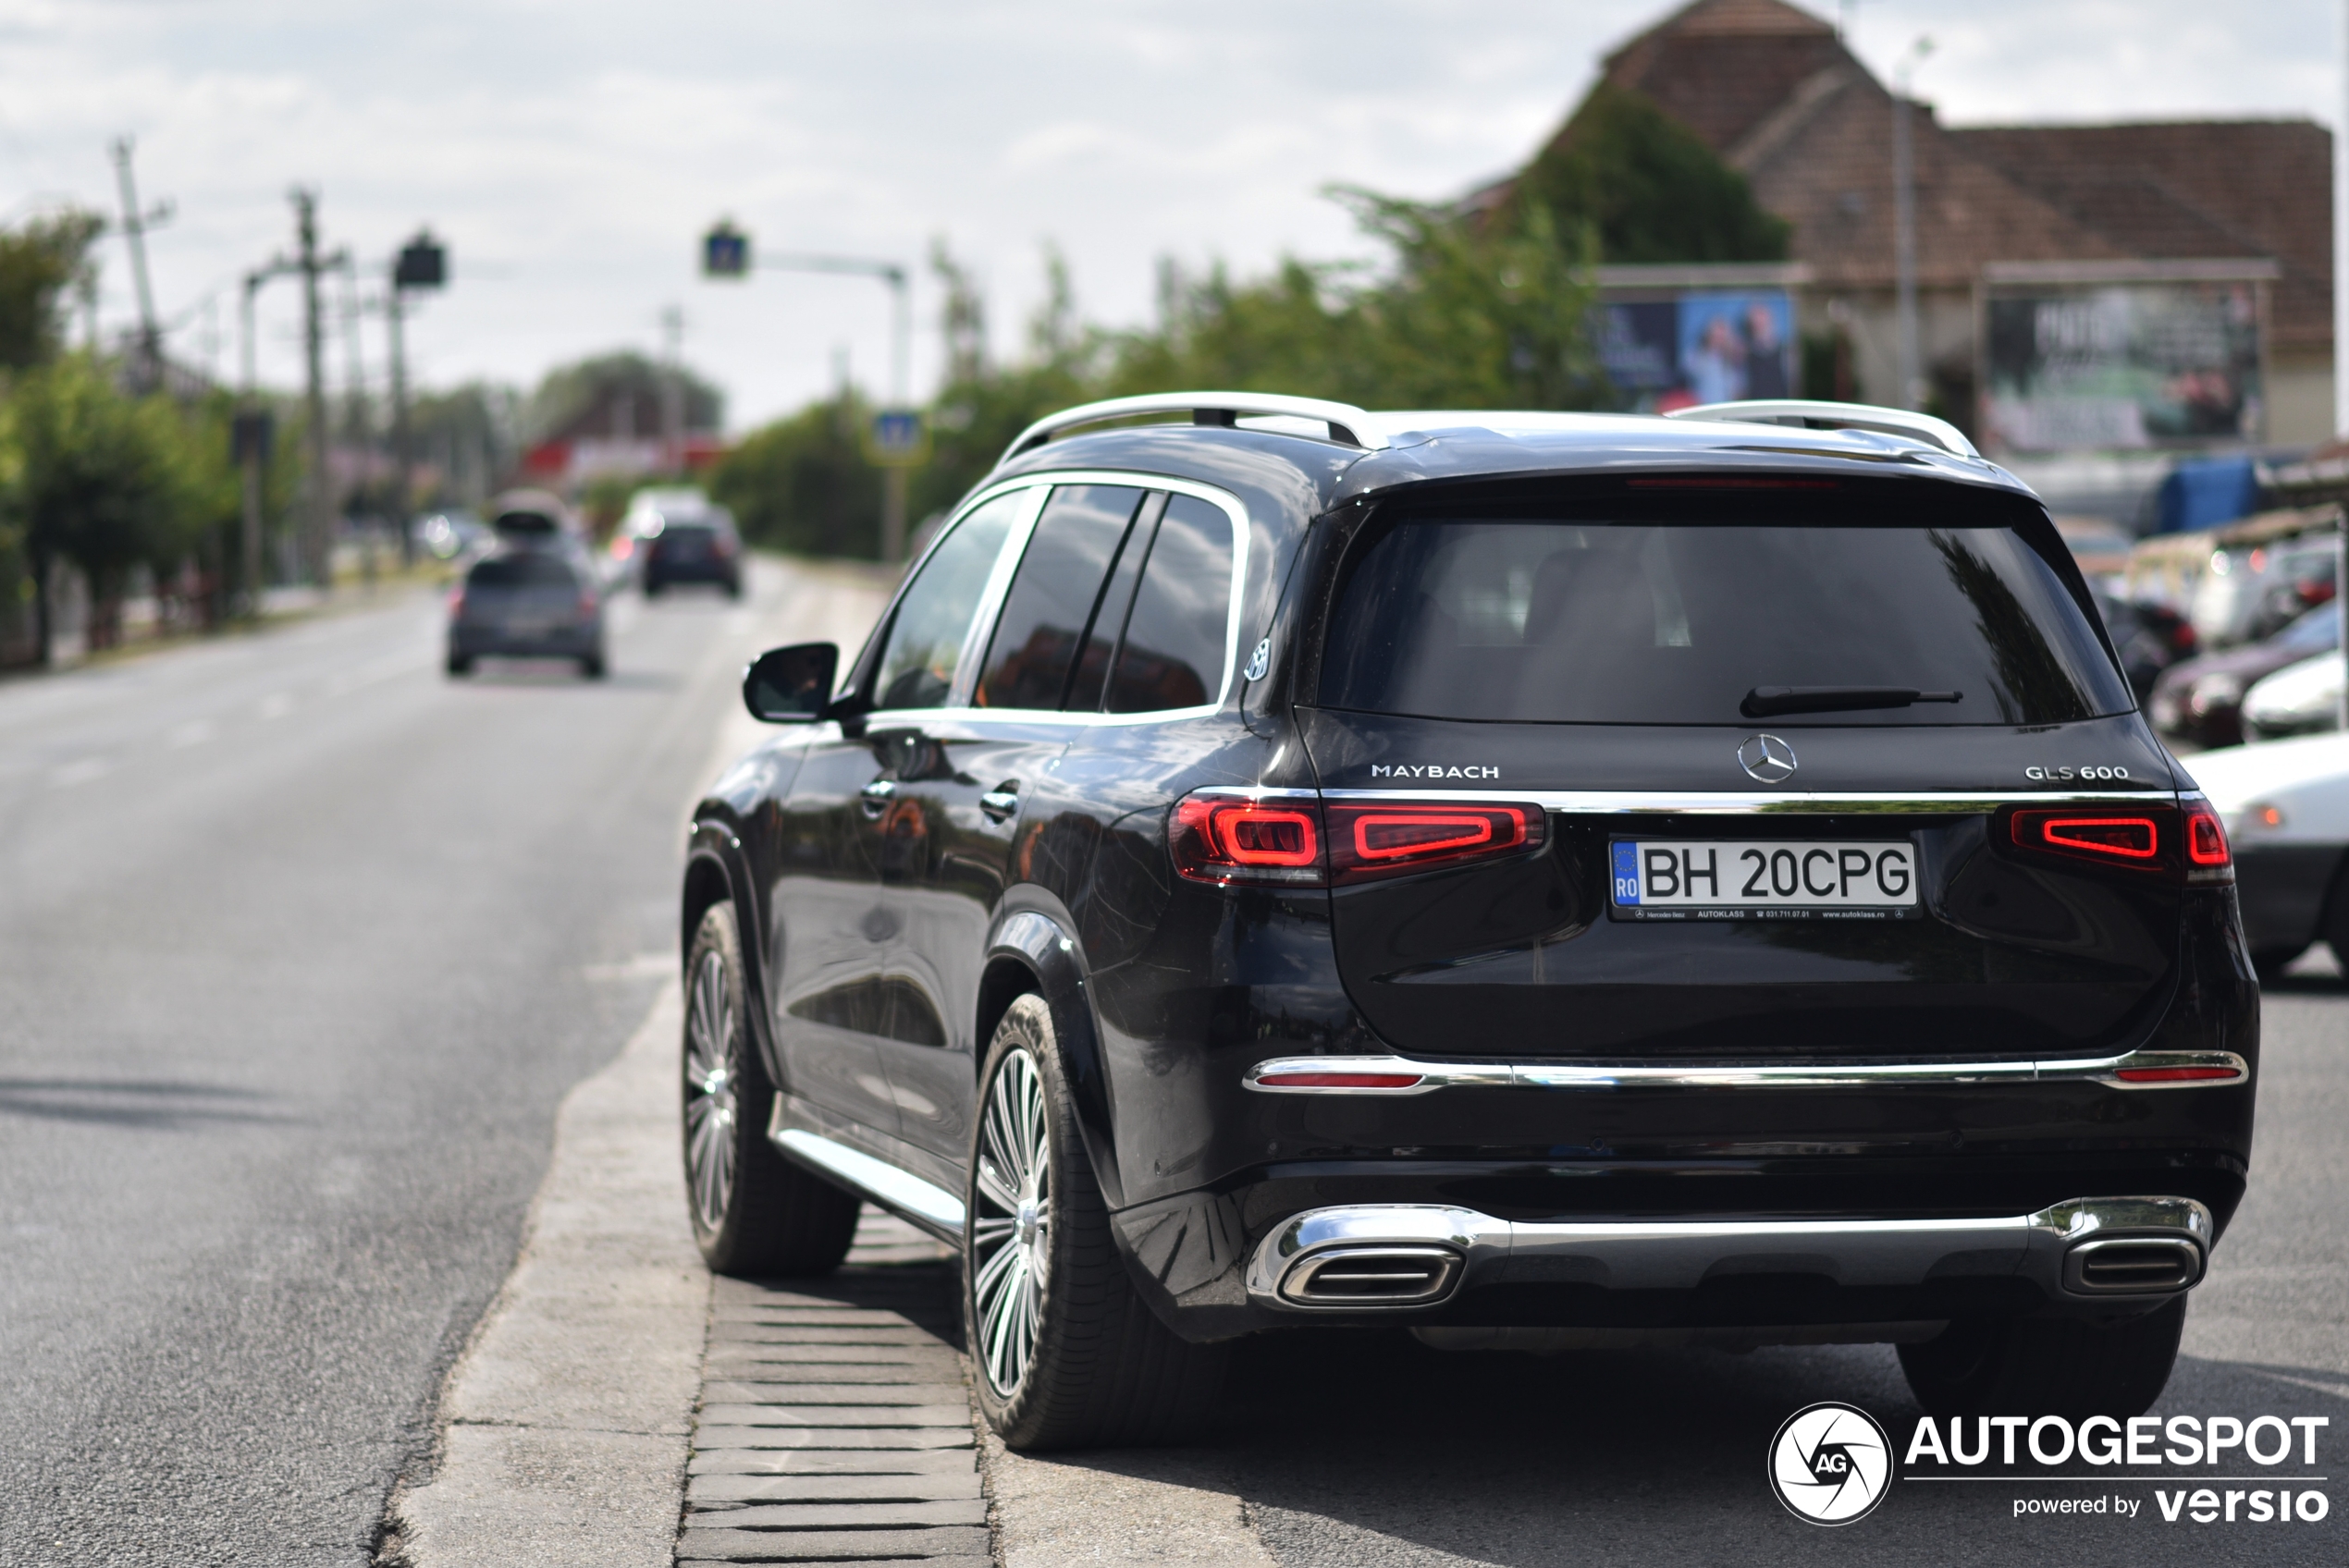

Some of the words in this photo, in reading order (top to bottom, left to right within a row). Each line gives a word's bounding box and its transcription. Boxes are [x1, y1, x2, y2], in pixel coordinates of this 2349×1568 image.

[1371, 765, 1499, 779] MAYBACH
[2024, 766, 2074, 780] GLS
[2080, 766, 2129, 780] 600
[1642, 848, 1719, 898] BH
[1740, 848, 1910, 898] 20CPG
[1617, 877, 1638, 898] RO
[1697, 910, 1744, 918] AUTOKLASS
[1765, 910, 1810, 918] 031.711.07.01
[1822, 910, 1886, 918] www.autoklass.ro
